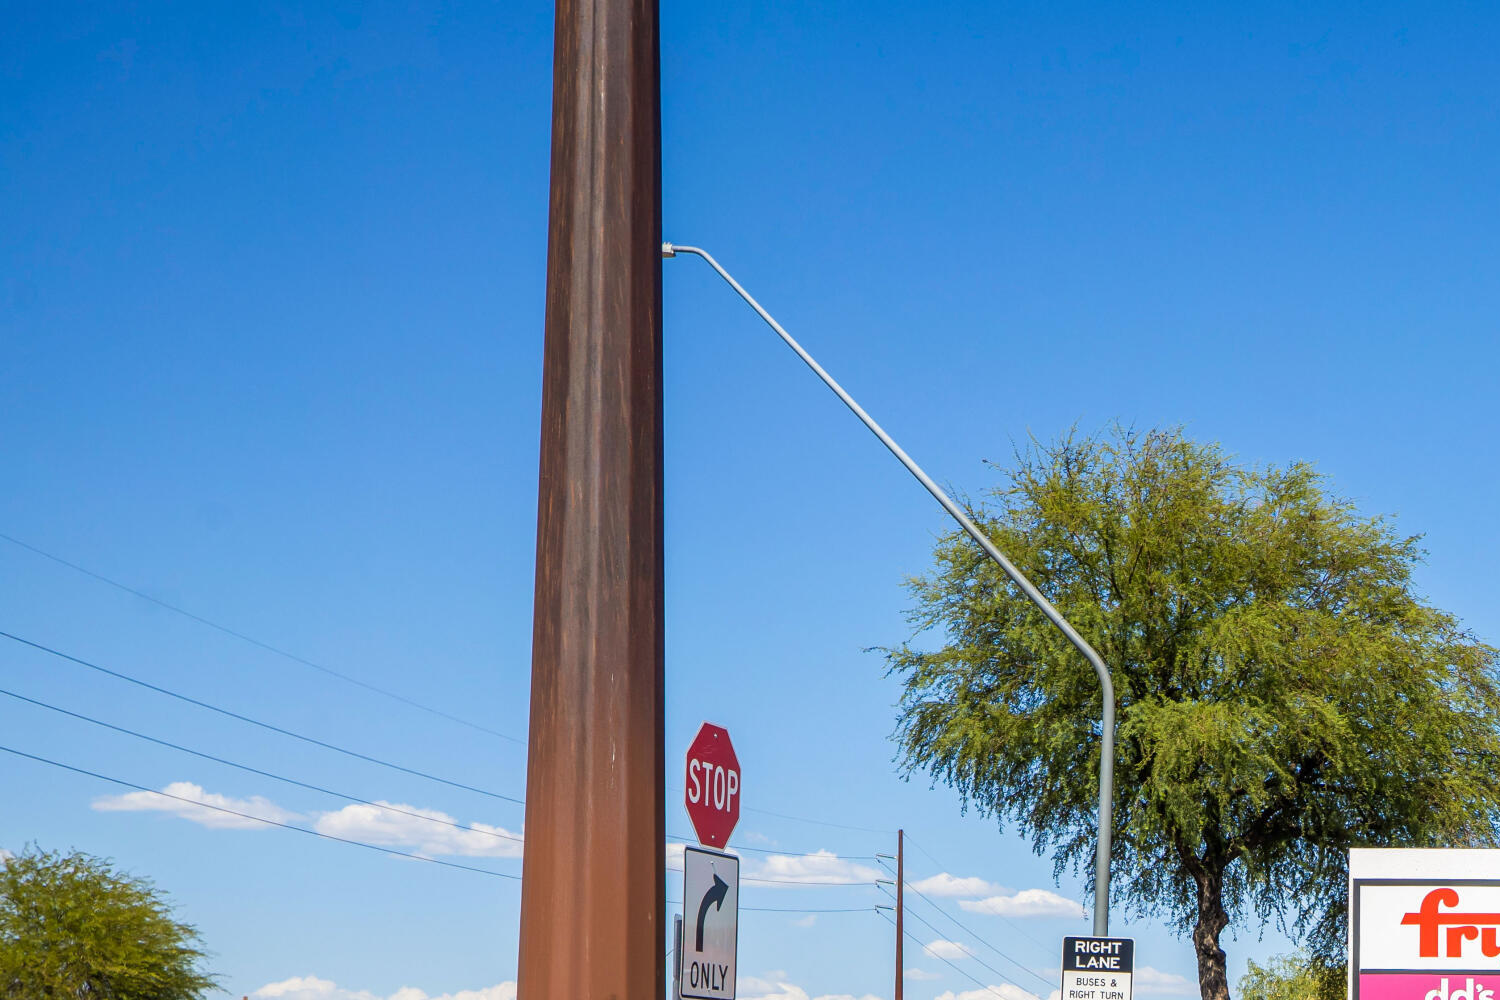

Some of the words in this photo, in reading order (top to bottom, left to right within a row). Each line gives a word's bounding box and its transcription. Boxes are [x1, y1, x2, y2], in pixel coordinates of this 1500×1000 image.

[688, 758, 739, 812] STOP
[1075, 940, 1122, 954] RIGHT
[1075, 955, 1120, 969] LANE
[691, 961, 729, 992] ONLY
[1076, 977, 1106, 987] BUSES
[1110, 979, 1117, 987] &
[1069, 990, 1095, 999] RIGHT
[1101, 991, 1124, 1000] TURN
